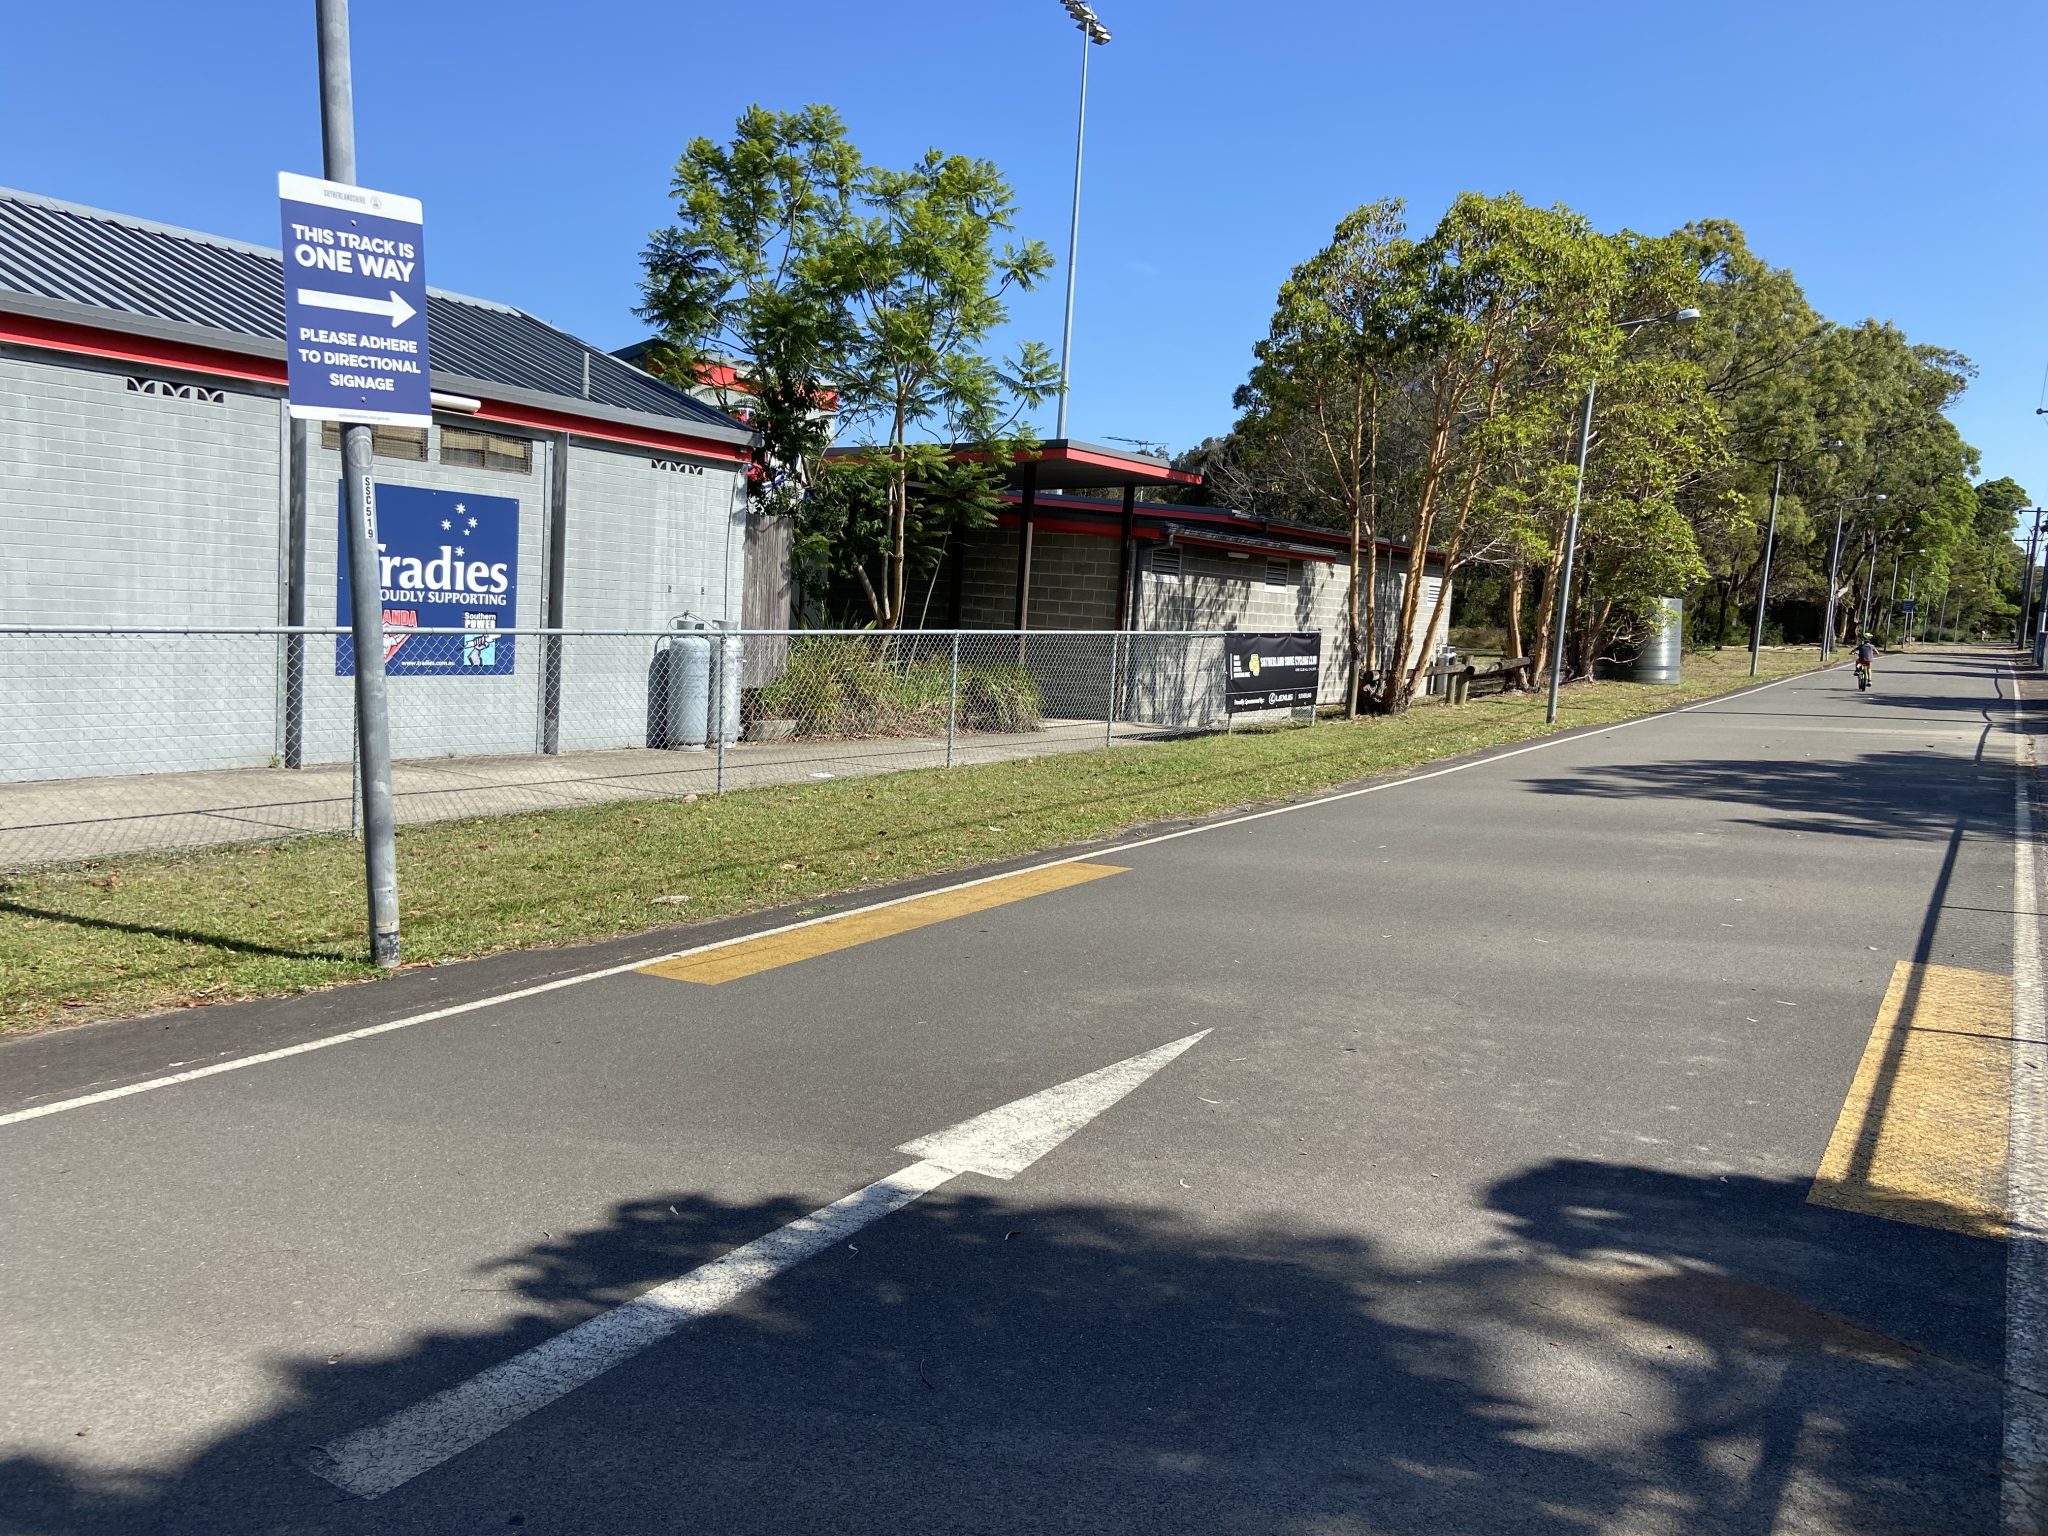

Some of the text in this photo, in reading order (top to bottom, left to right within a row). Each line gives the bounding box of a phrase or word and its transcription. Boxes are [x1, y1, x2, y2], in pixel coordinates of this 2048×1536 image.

[292, 223, 415, 259] THIS TRACK IS
[294, 243, 415, 283] ONE WAY
[300, 327, 418, 354] PLEASE ADHERE
[298, 348, 421, 374] TO DIRECTIONAL
[329, 372, 395, 392] SIGNAGE
[377, 543, 509, 594] radies
[380, 588, 507, 606] OUDLY SUPPORTING
[382, 609, 418, 628] ANDA
[464, 612, 497, 621] Southern
